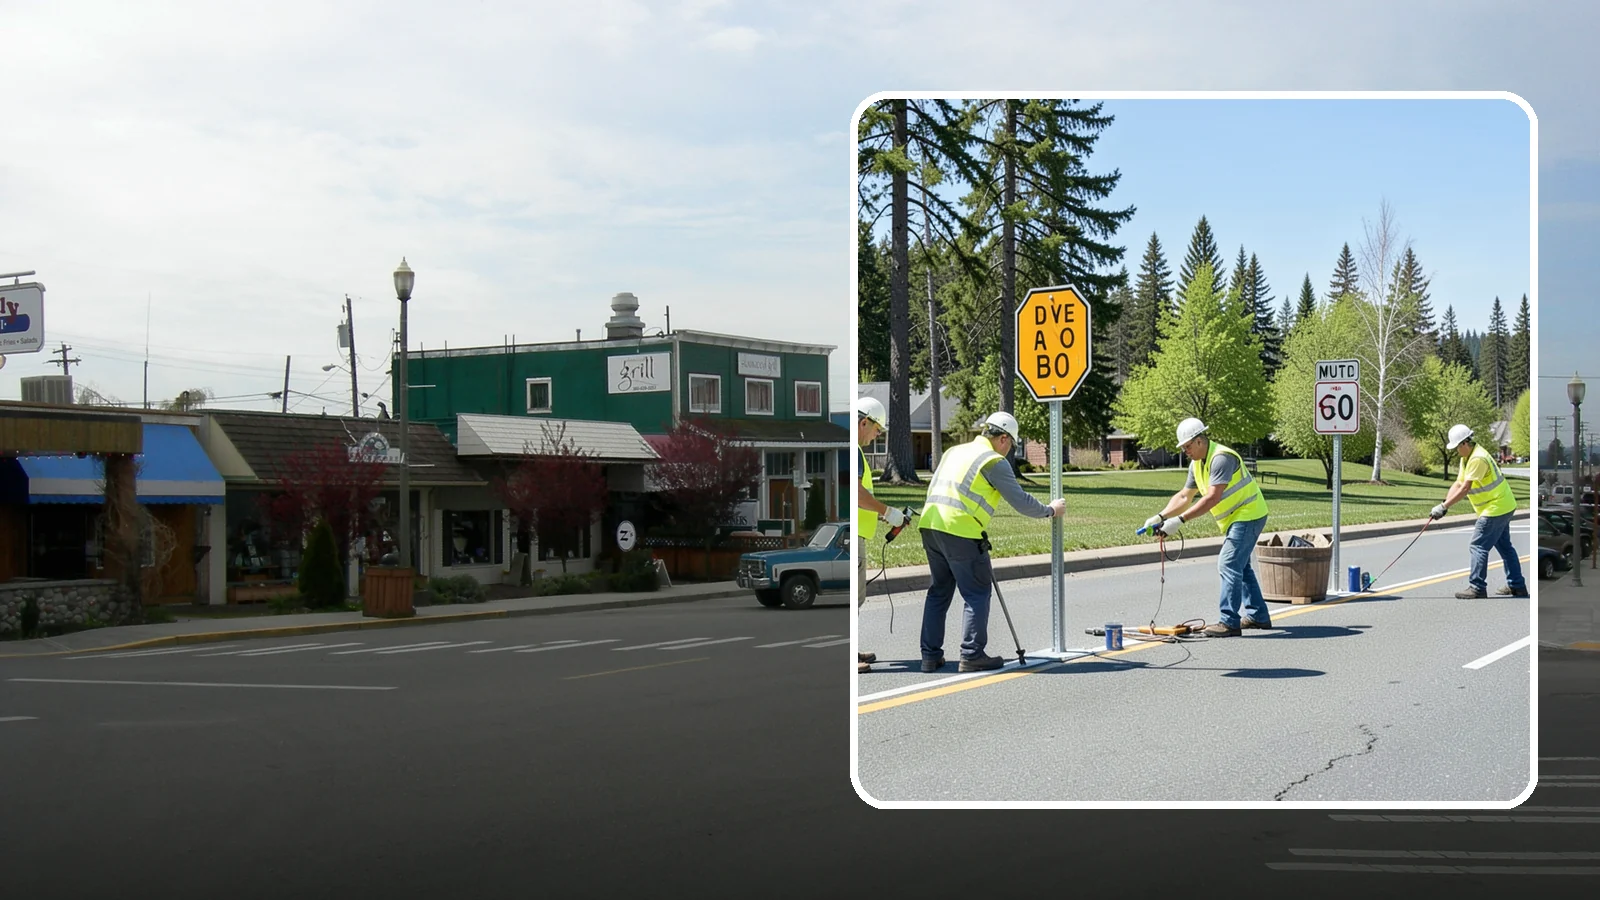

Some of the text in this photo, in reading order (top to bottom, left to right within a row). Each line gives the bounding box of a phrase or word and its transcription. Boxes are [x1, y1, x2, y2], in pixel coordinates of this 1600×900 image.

[0, 297, 19, 323] ly
[1035, 304, 1074, 325] DVE
[20, 337, 38, 345] Salads
[1034, 327, 1075, 351] A O
[617, 356, 654, 391] grill
[1037, 352, 1070, 379] BO
[1319, 394, 1354, 421] 60
